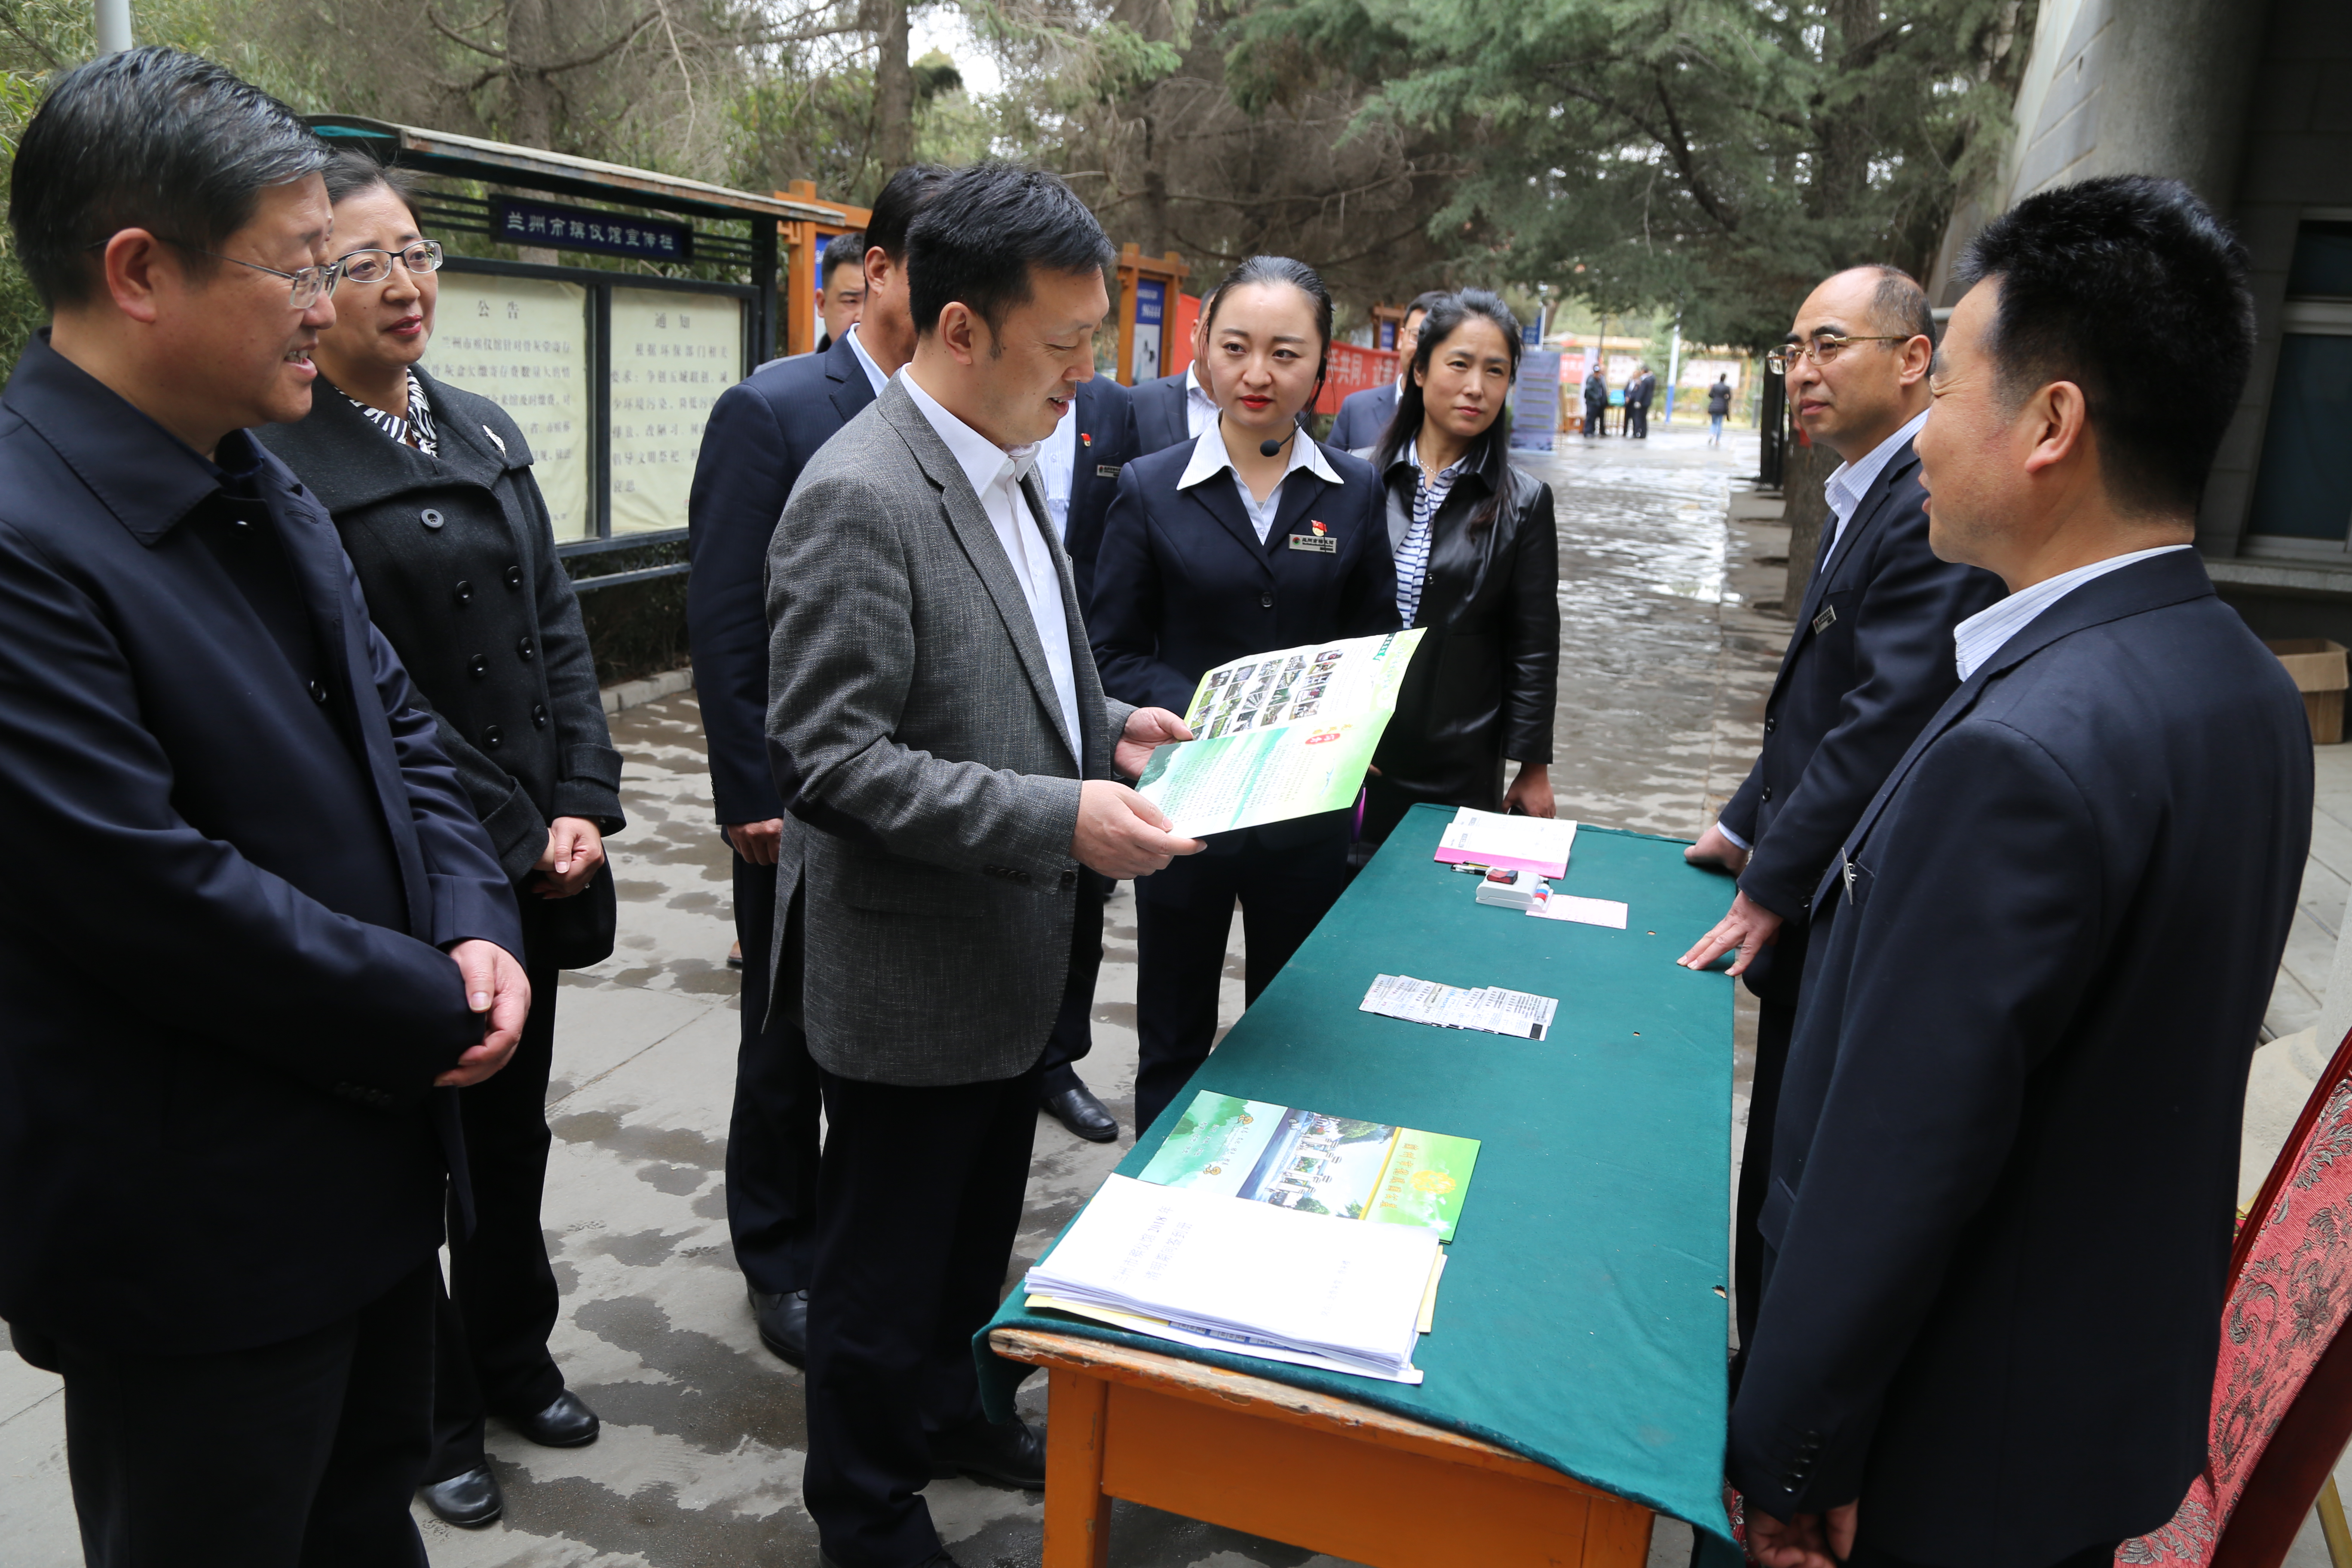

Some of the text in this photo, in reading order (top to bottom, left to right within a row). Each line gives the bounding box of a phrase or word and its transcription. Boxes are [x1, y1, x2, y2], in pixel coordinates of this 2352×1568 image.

[507, 211, 674, 251] 兰州市殡仪馆宣传栏
[478, 300, 519, 319] 公告
[655, 312, 690, 328] 通知
